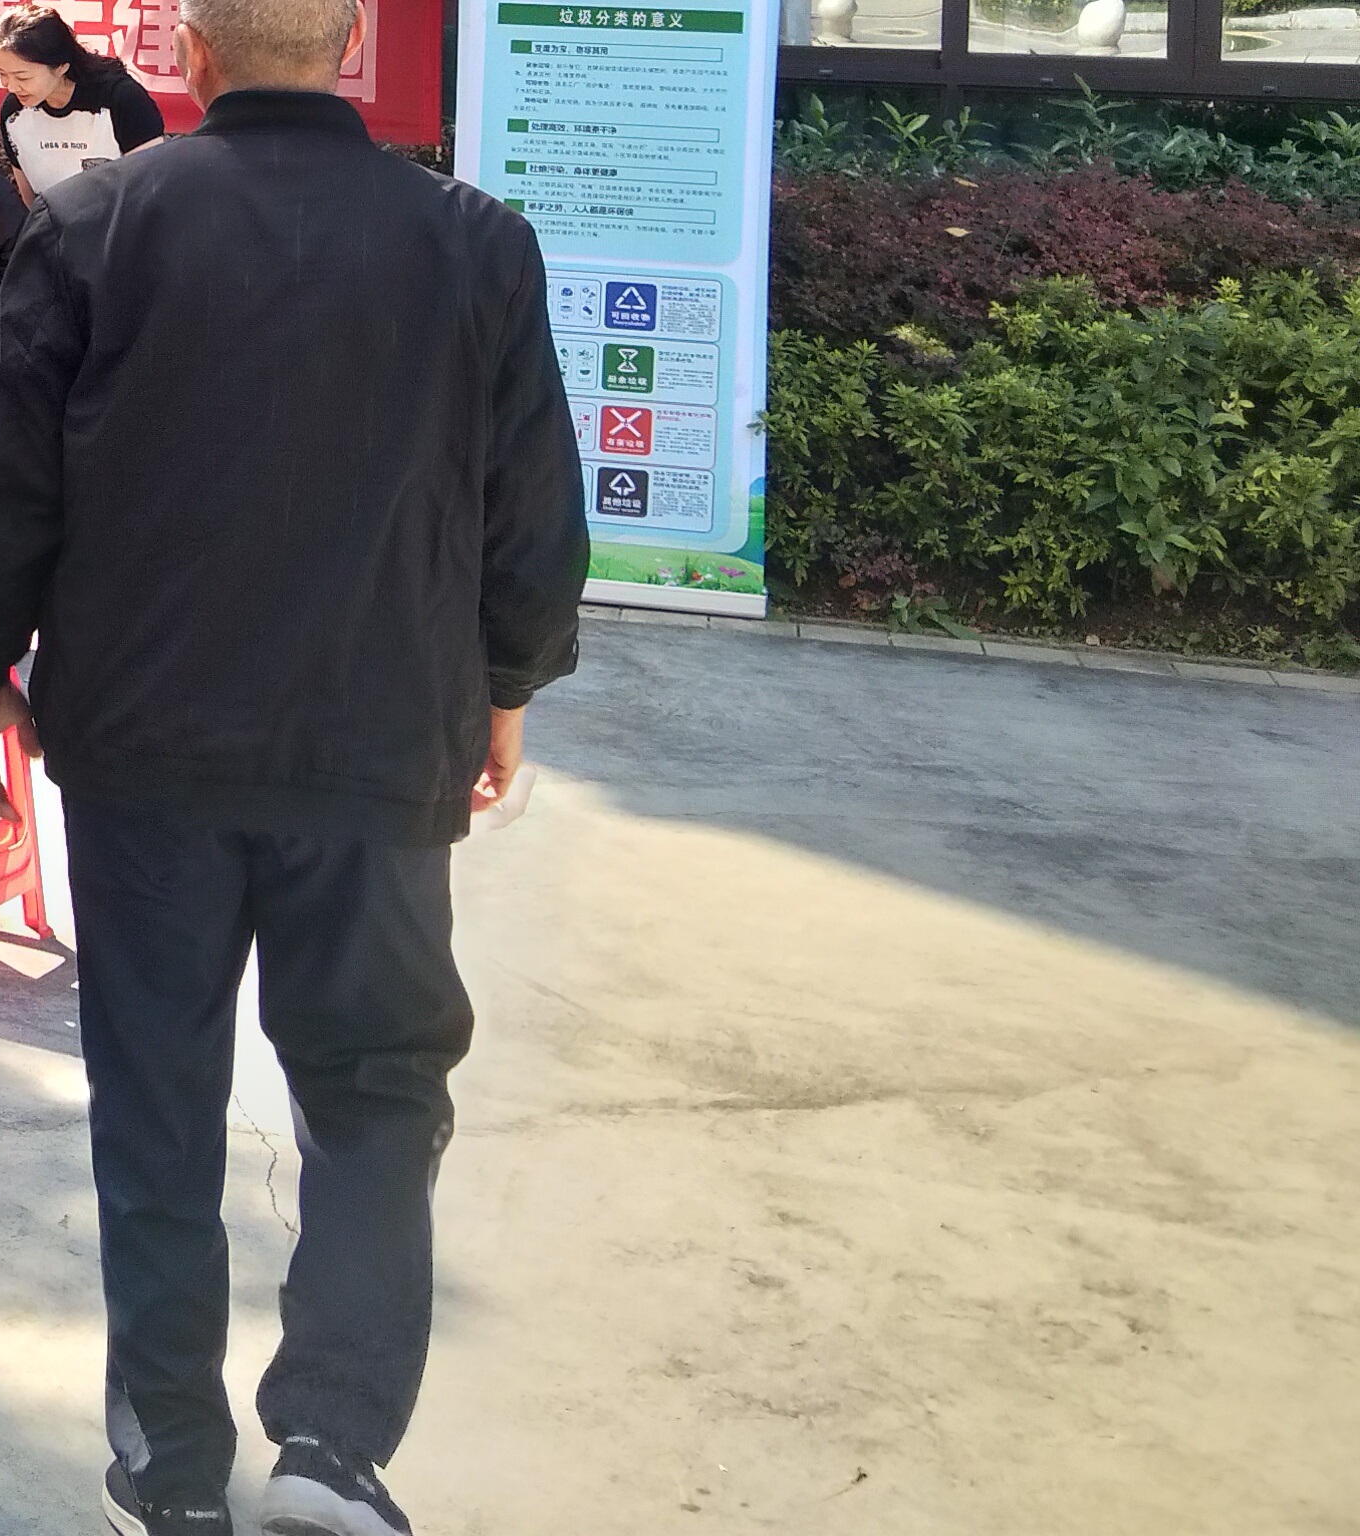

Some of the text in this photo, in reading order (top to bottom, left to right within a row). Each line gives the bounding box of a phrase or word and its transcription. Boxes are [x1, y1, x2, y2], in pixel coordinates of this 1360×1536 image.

[559, 7, 684, 30] 垃圾分类的意义
[610, 311, 651, 322] 可回收物
